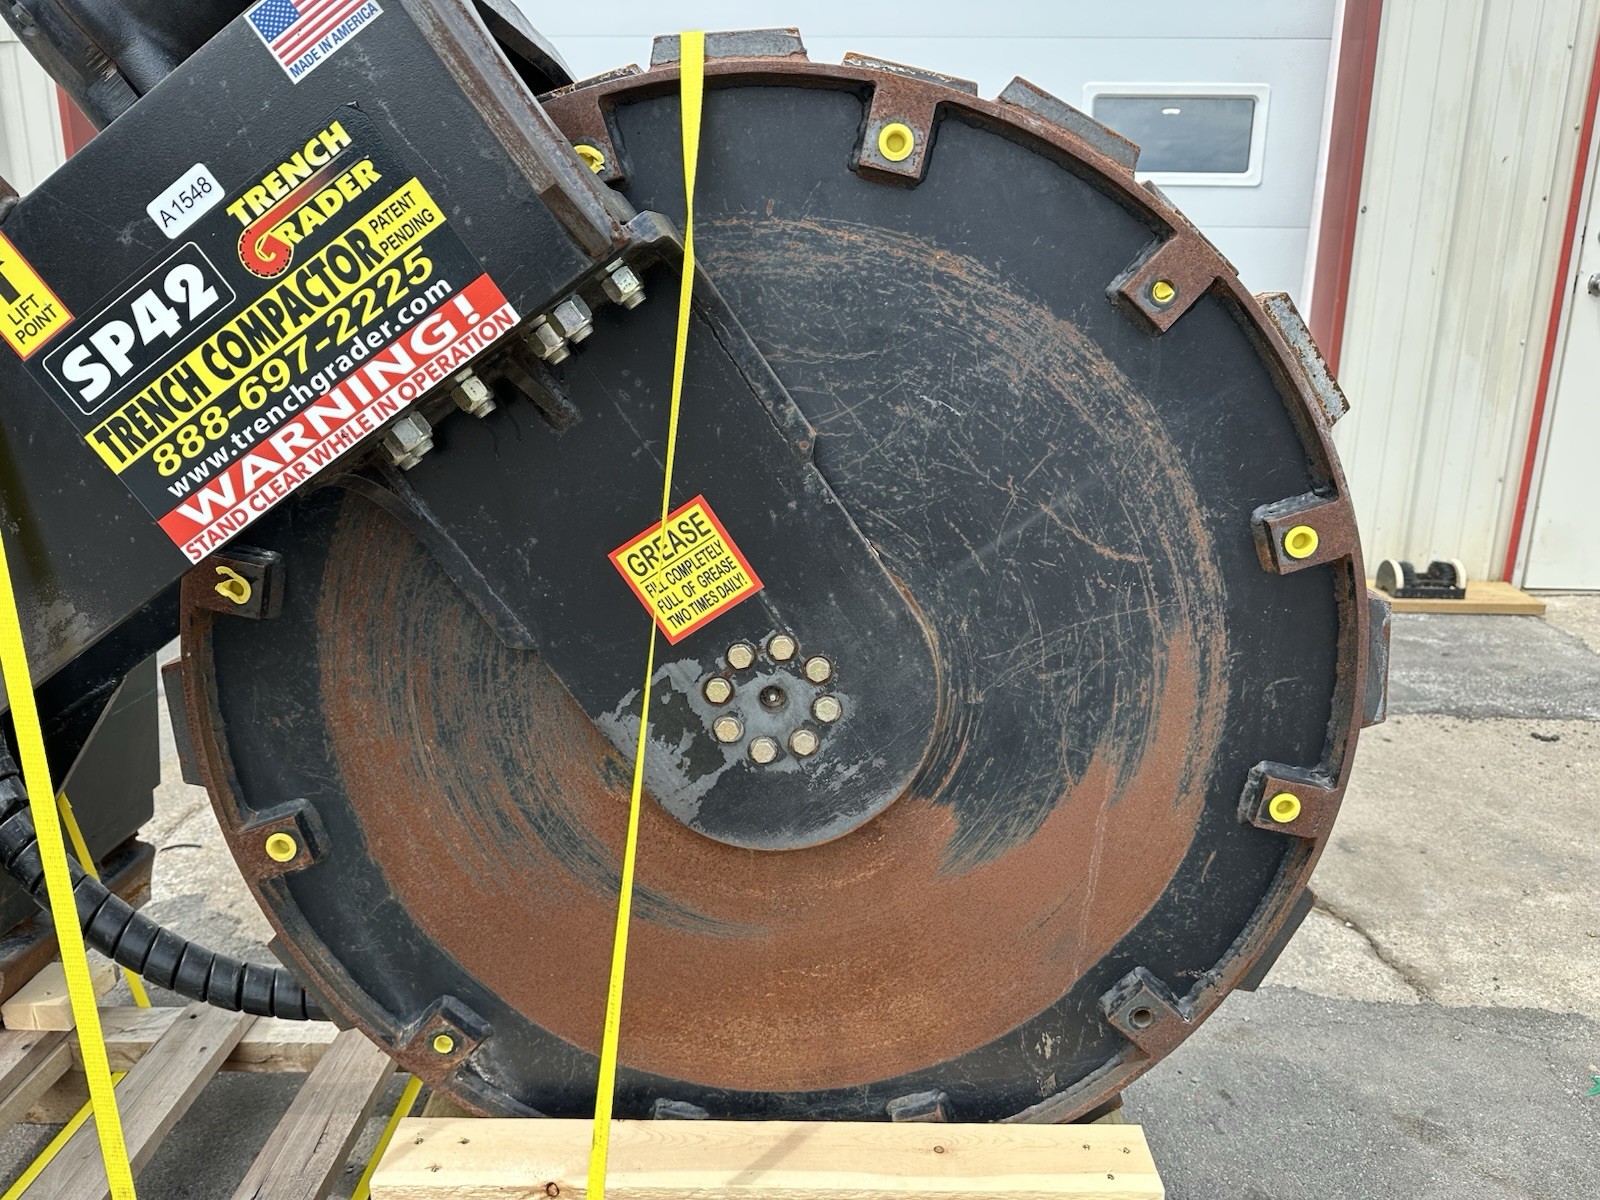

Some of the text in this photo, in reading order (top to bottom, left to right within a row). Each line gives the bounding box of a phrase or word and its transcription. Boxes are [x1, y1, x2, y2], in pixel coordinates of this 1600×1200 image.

[288, 2, 378, 78] MADE IN AMERICA
[225, 120, 352, 227] TRENCH
[238, 157, 382, 279] GRADER
[369, 190, 416, 234] PATENT
[379, 208, 435, 256] PENDING
[7, 293, 40, 326] LIFT
[14, 303, 58, 345] POINT
[62, 263, 219, 403] SP42
[93, 228, 384, 464] TRENCH COMPACTOR
[152, 245, 433, 476] 888-697-2225
[167, 279, 453, 498] www.trenchgrader.com
[176, 293, 481, 526] WARNING!
[185, 308, 515, 560] STAND CLEAR WHILE IN OPERATION
[627, 511, 712, 577] GREASE
[665, 539, 725, 586] COMPLETELY
[657, 556, 737, 614] FULL OF GREASE
[667, 572, 748, 629] TWO TIMES DAILY!
